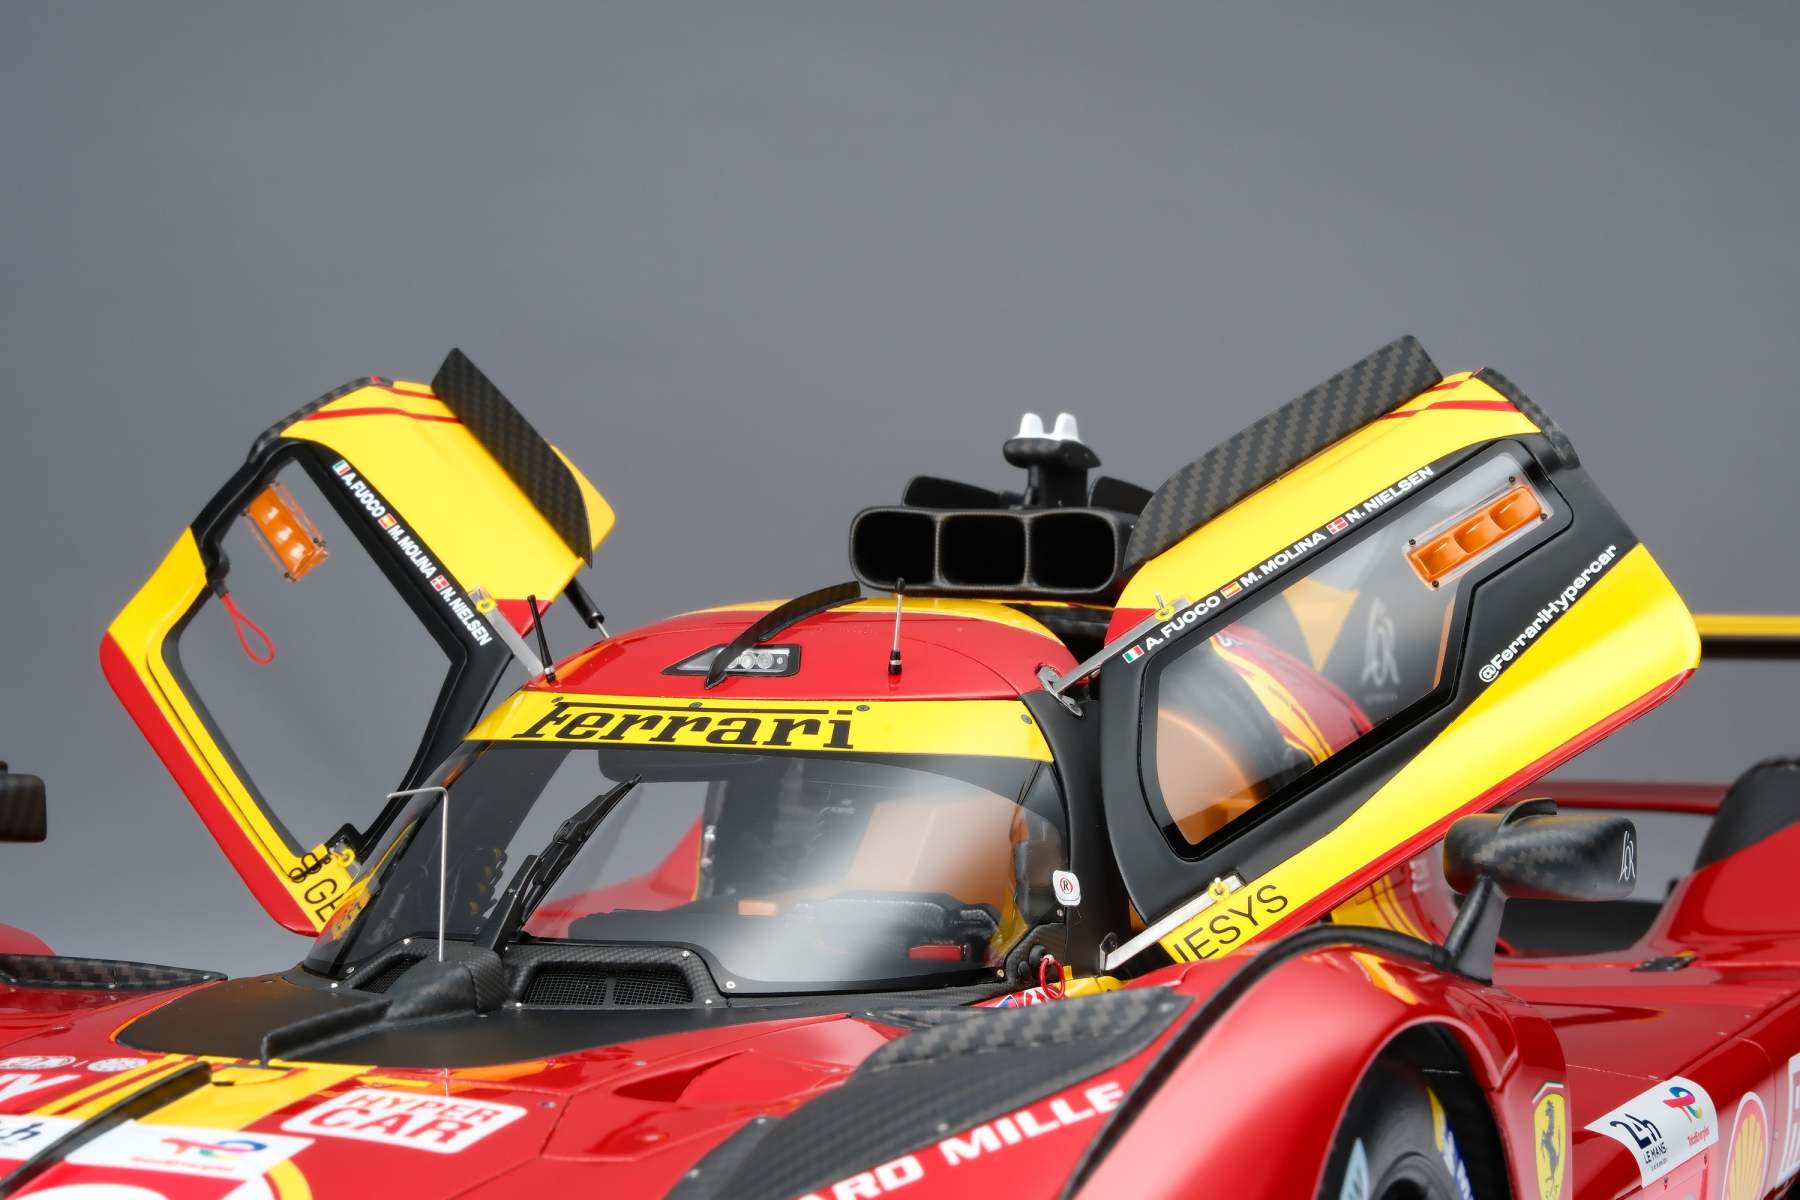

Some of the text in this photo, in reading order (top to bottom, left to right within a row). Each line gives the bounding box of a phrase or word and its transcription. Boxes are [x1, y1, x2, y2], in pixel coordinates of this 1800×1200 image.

[1160, 595, 1221, 638] FUOCO
[1260, 533, 1327, 575] MOLINA
[1364, 466, 1434, 513] NIELSEN
[448, 597, 492, 646] NIELSEN
[1478, 544, 1617, 683] @FerrariHypercar
[511, 700, 854, 749] Ferrari
[309, 1107, 475, 1144] CAR
[345, 1094, 503, 1123] HYPER
[798, 1081, 1125, 1200] RD MILLE
[1650, 1142, 1668, 1158] MANS
